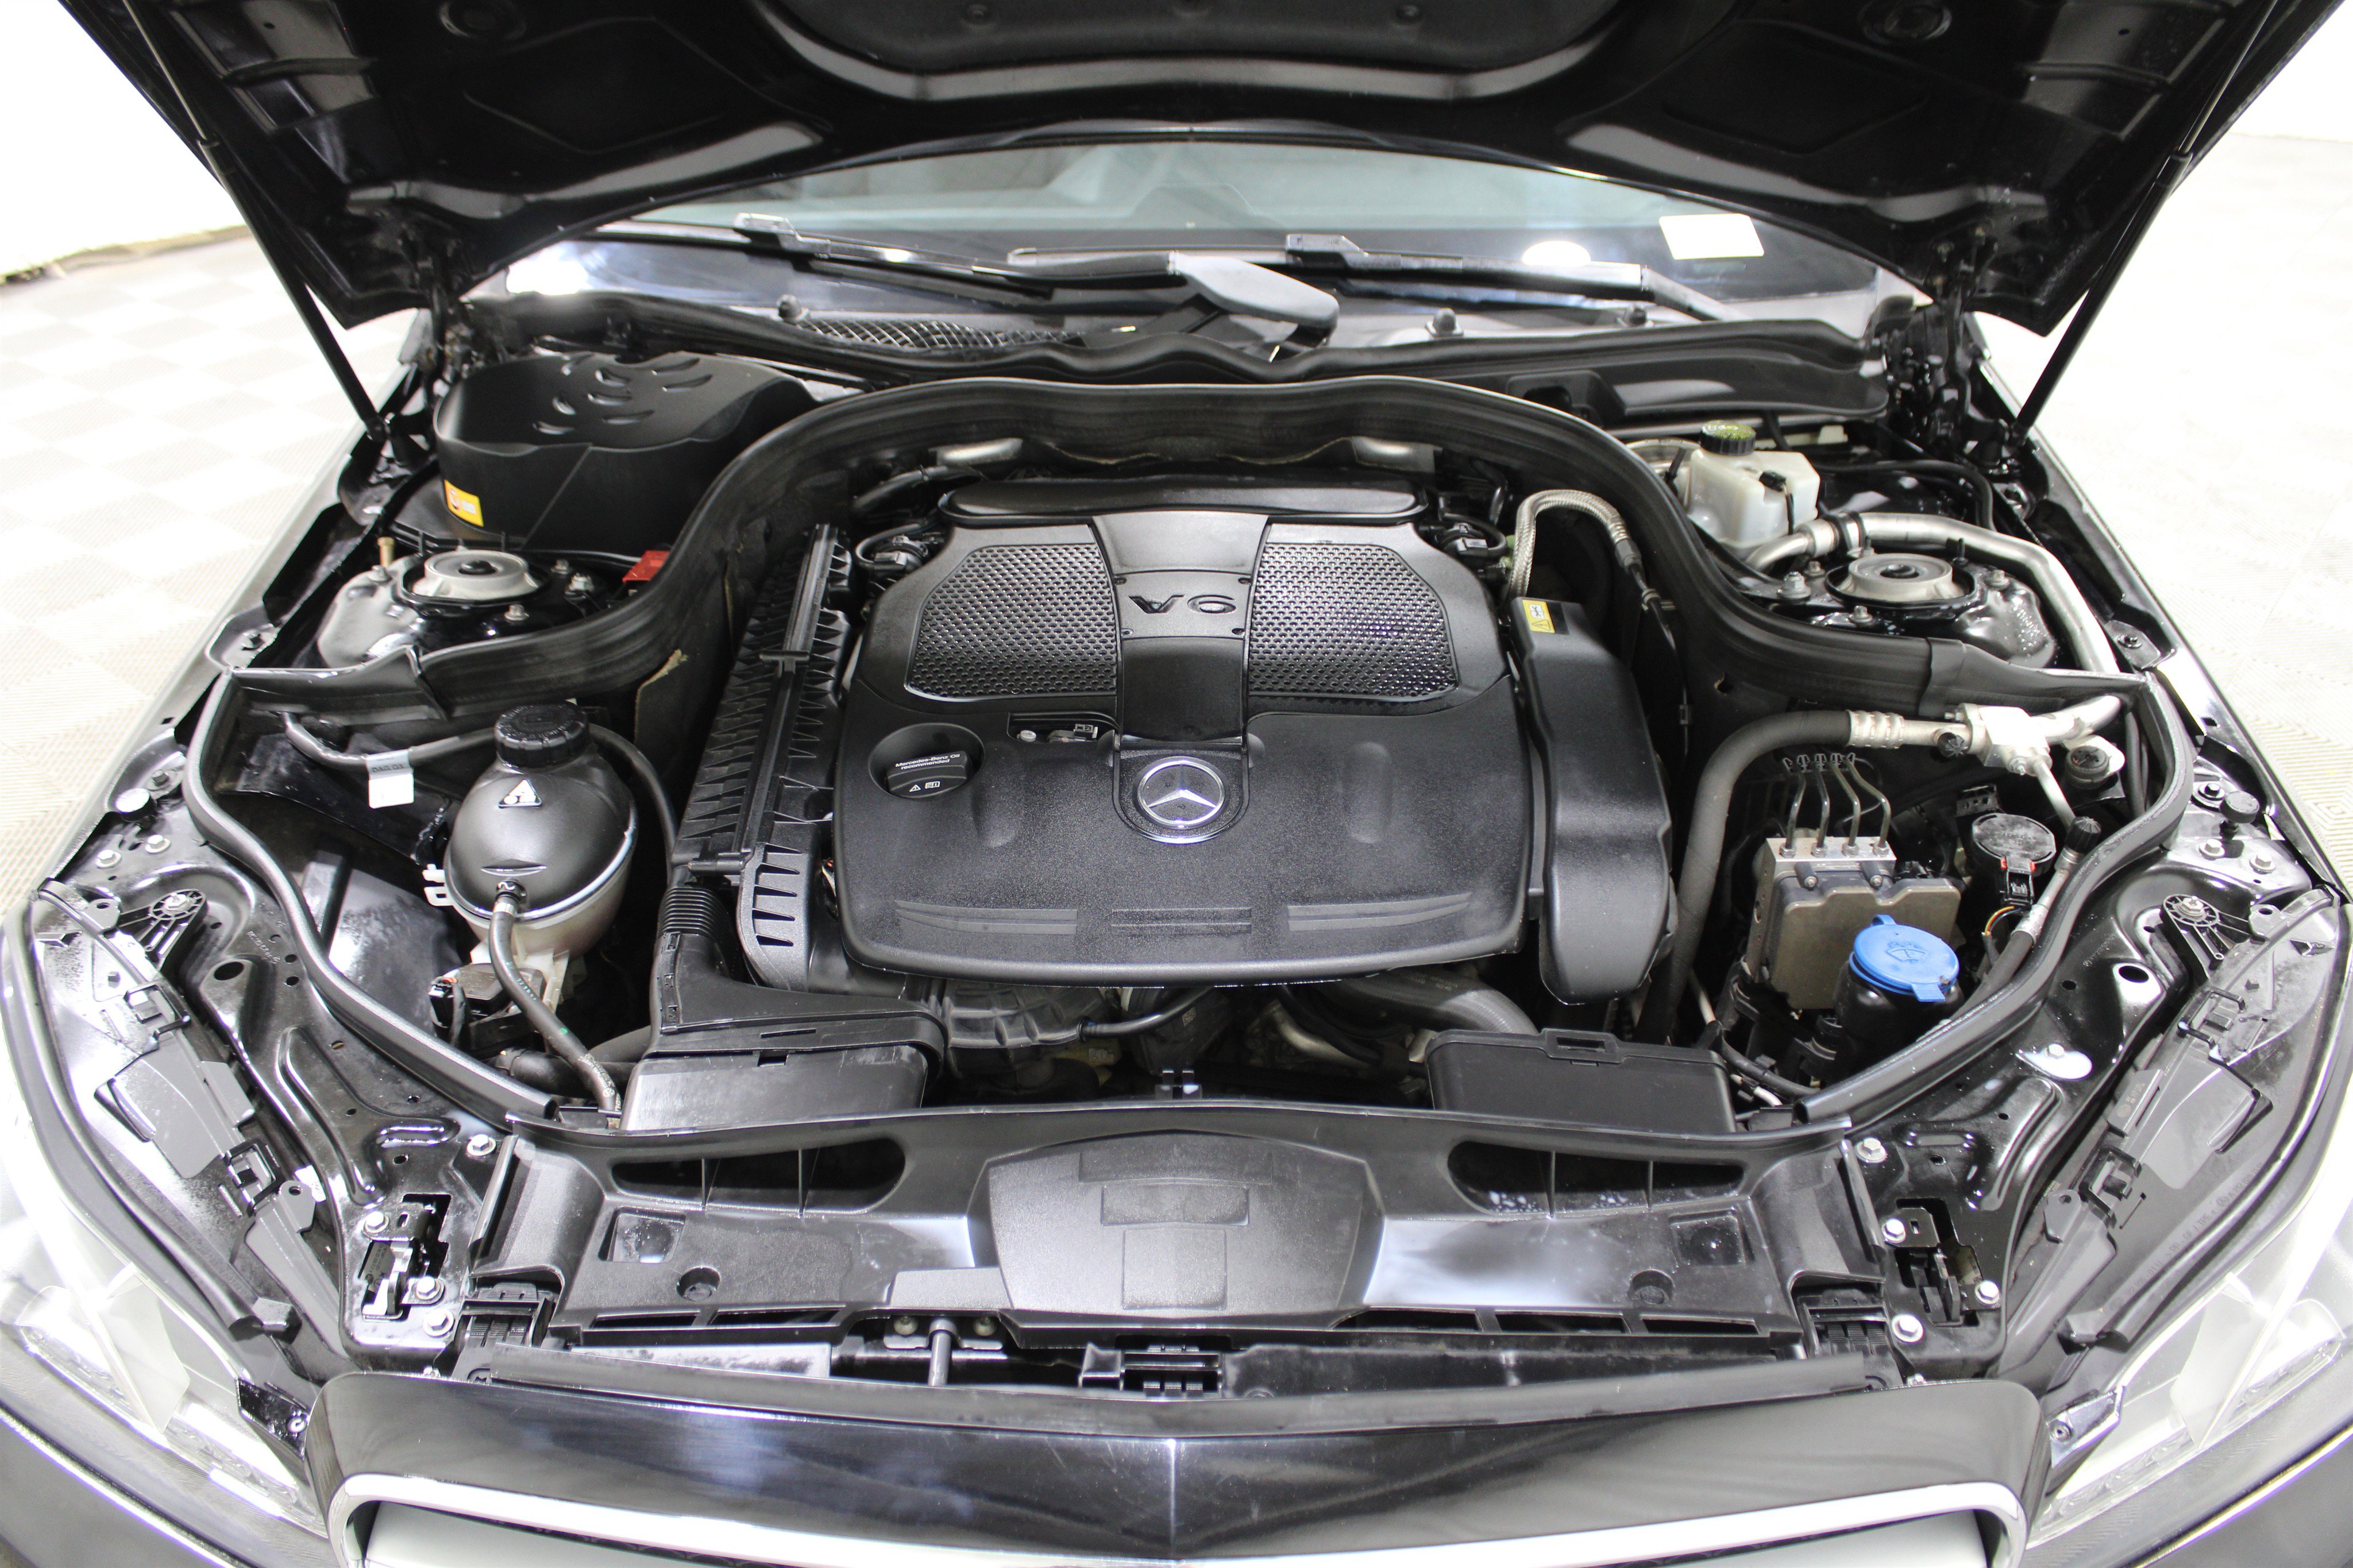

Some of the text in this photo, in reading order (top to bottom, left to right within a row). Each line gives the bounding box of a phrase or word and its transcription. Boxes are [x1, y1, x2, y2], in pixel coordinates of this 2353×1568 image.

[1129, 594, 1237, 613] V6
[895, 755, 948, 767] Mercedes-Benz
[900, 759, 950, 770] recommended
